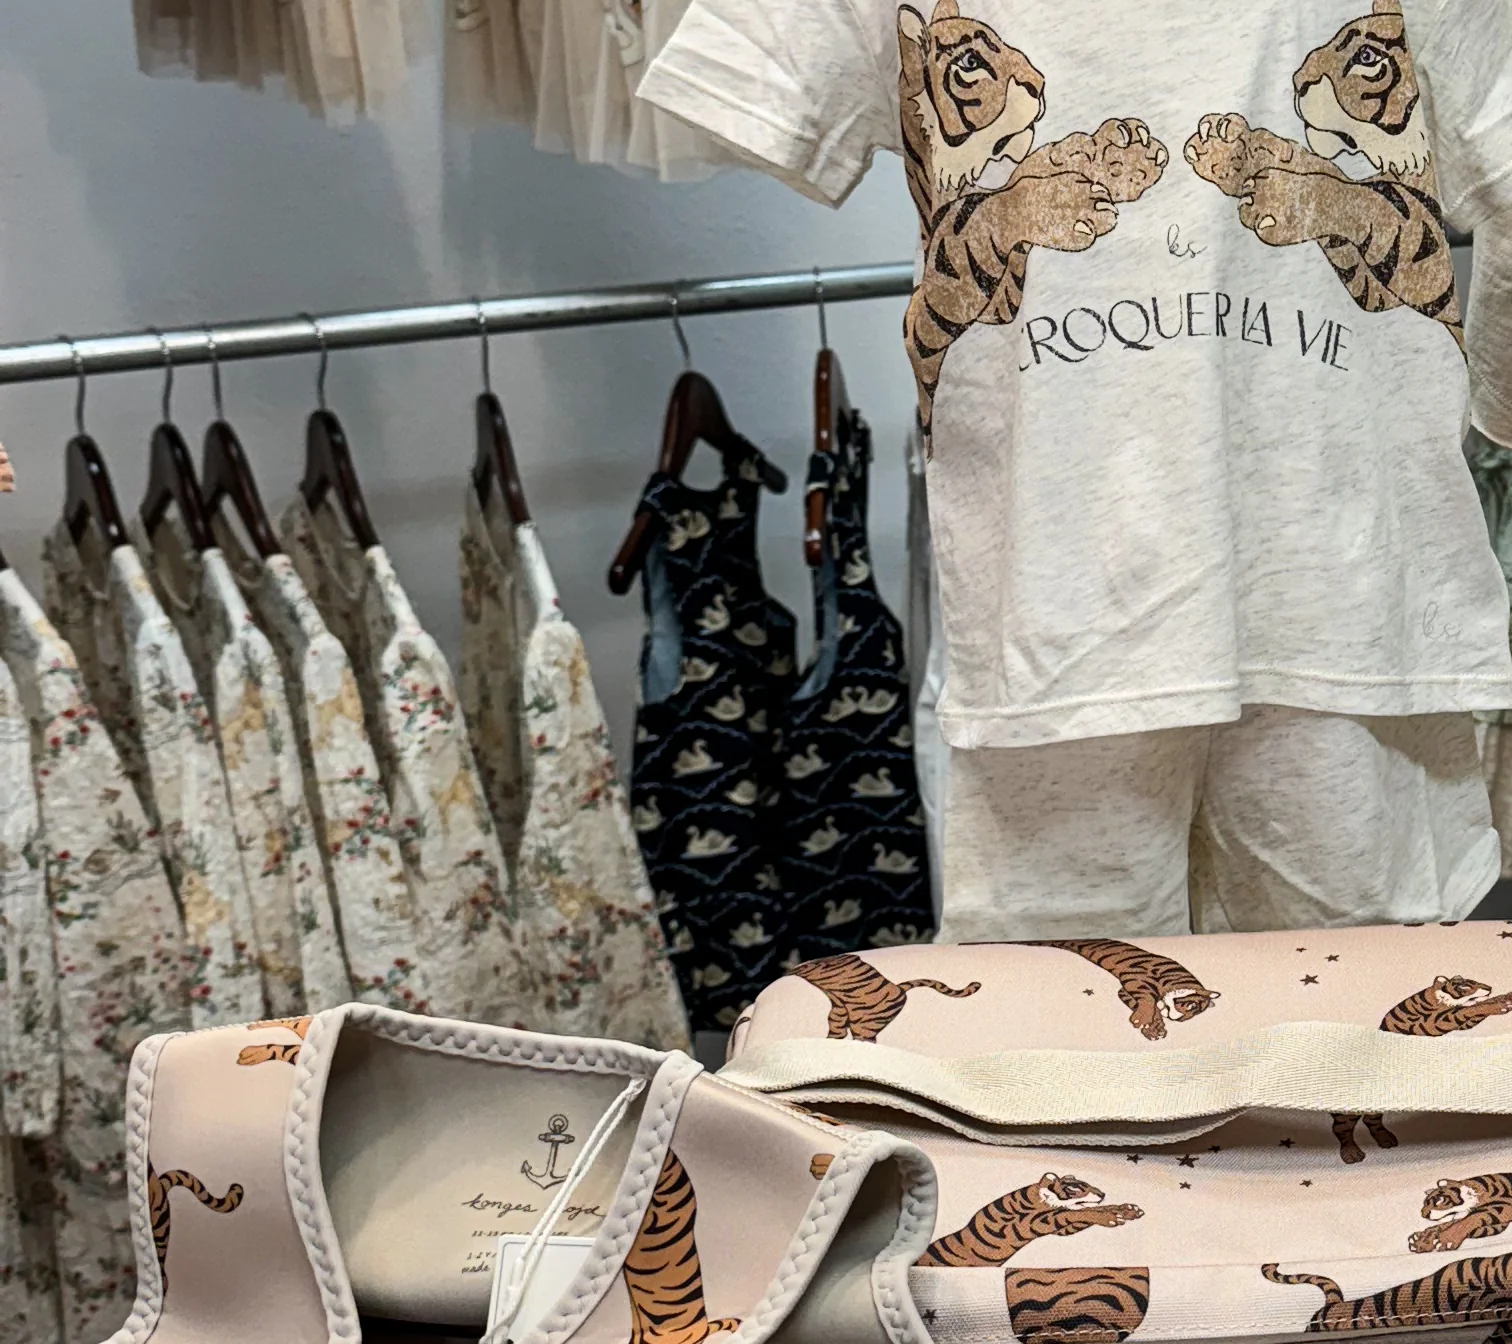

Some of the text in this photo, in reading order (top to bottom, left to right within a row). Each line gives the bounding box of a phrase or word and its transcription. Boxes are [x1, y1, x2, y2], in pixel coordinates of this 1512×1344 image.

[1019, 292, 1352, 372] ROQUER LA VIE
